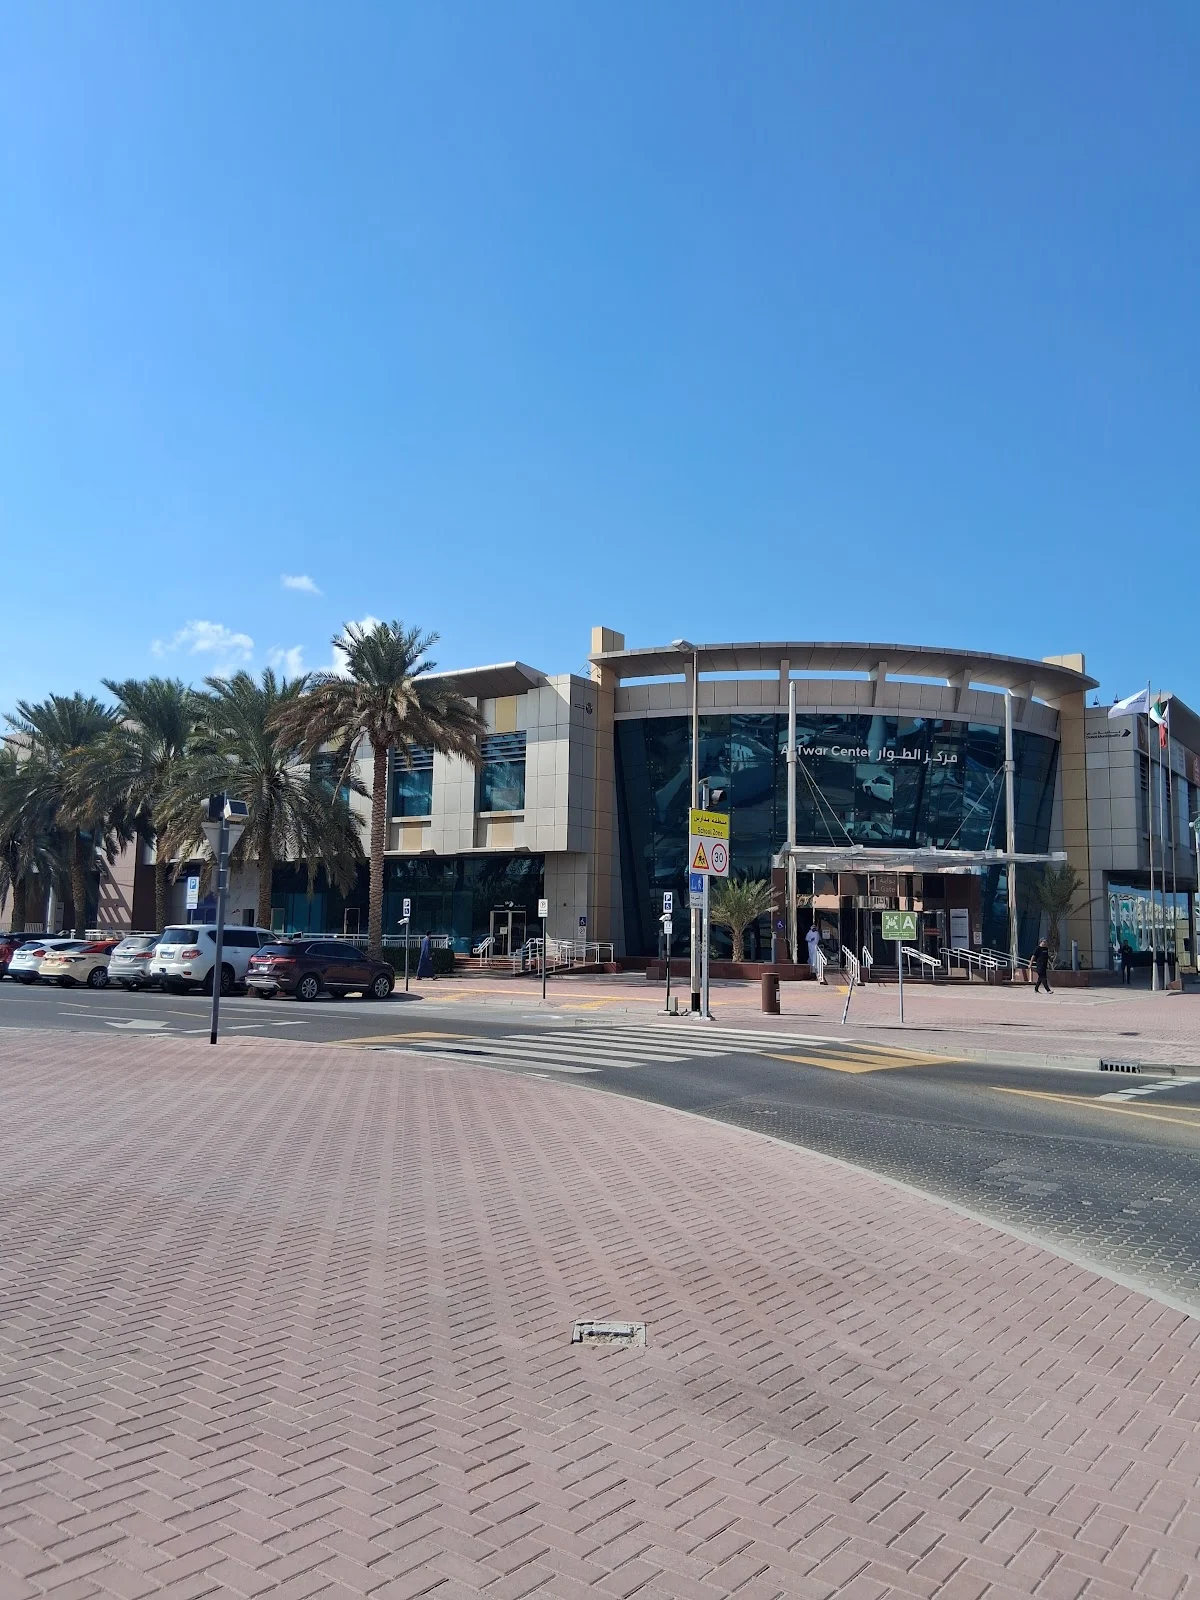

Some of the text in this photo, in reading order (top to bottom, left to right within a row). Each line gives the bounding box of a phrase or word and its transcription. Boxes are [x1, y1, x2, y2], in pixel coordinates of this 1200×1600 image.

[796, 744, 829, 756] Twar
[831, 745, 873, 757] Center
[875, 746, 958, 765] مركز الطوار
[697, 826, 723, 837] School Zone
[714, 851, 724, 863] 30
[880, 885, 896, 893] Gate
[903, 915, 915, 930] A
